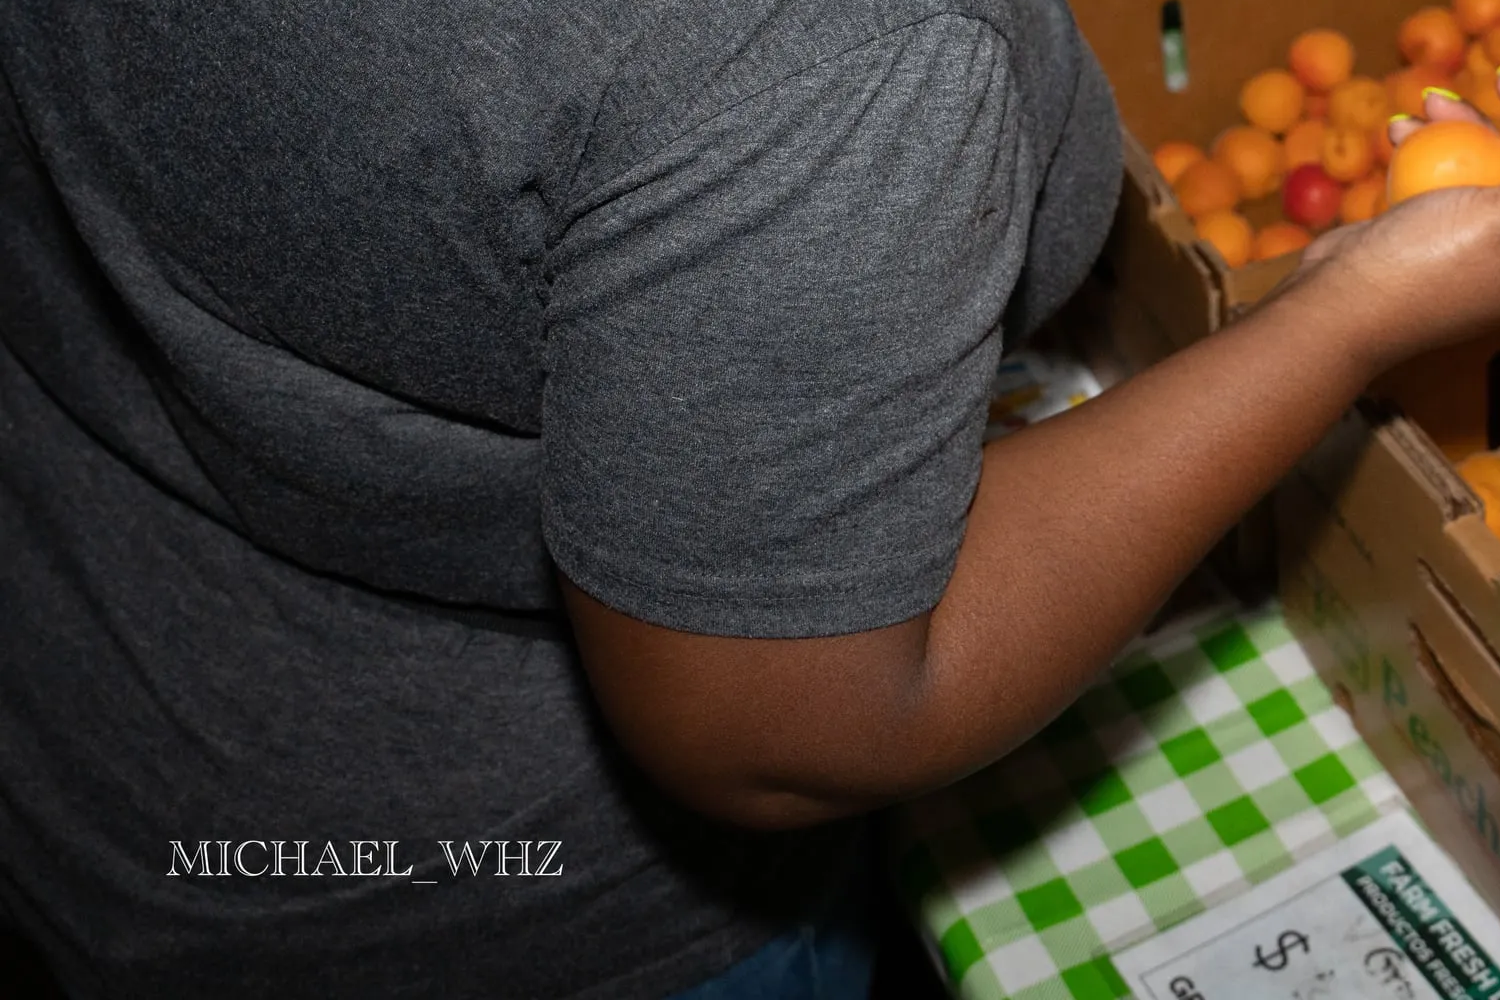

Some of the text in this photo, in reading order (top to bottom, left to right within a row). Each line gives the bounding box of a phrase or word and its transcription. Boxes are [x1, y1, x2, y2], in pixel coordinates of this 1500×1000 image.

[1356, 874, 1434, 963] PRODUCTOS
[1379, 860, 1440, 924] FARM
[1428, 917, 1500, 993] FRESH
